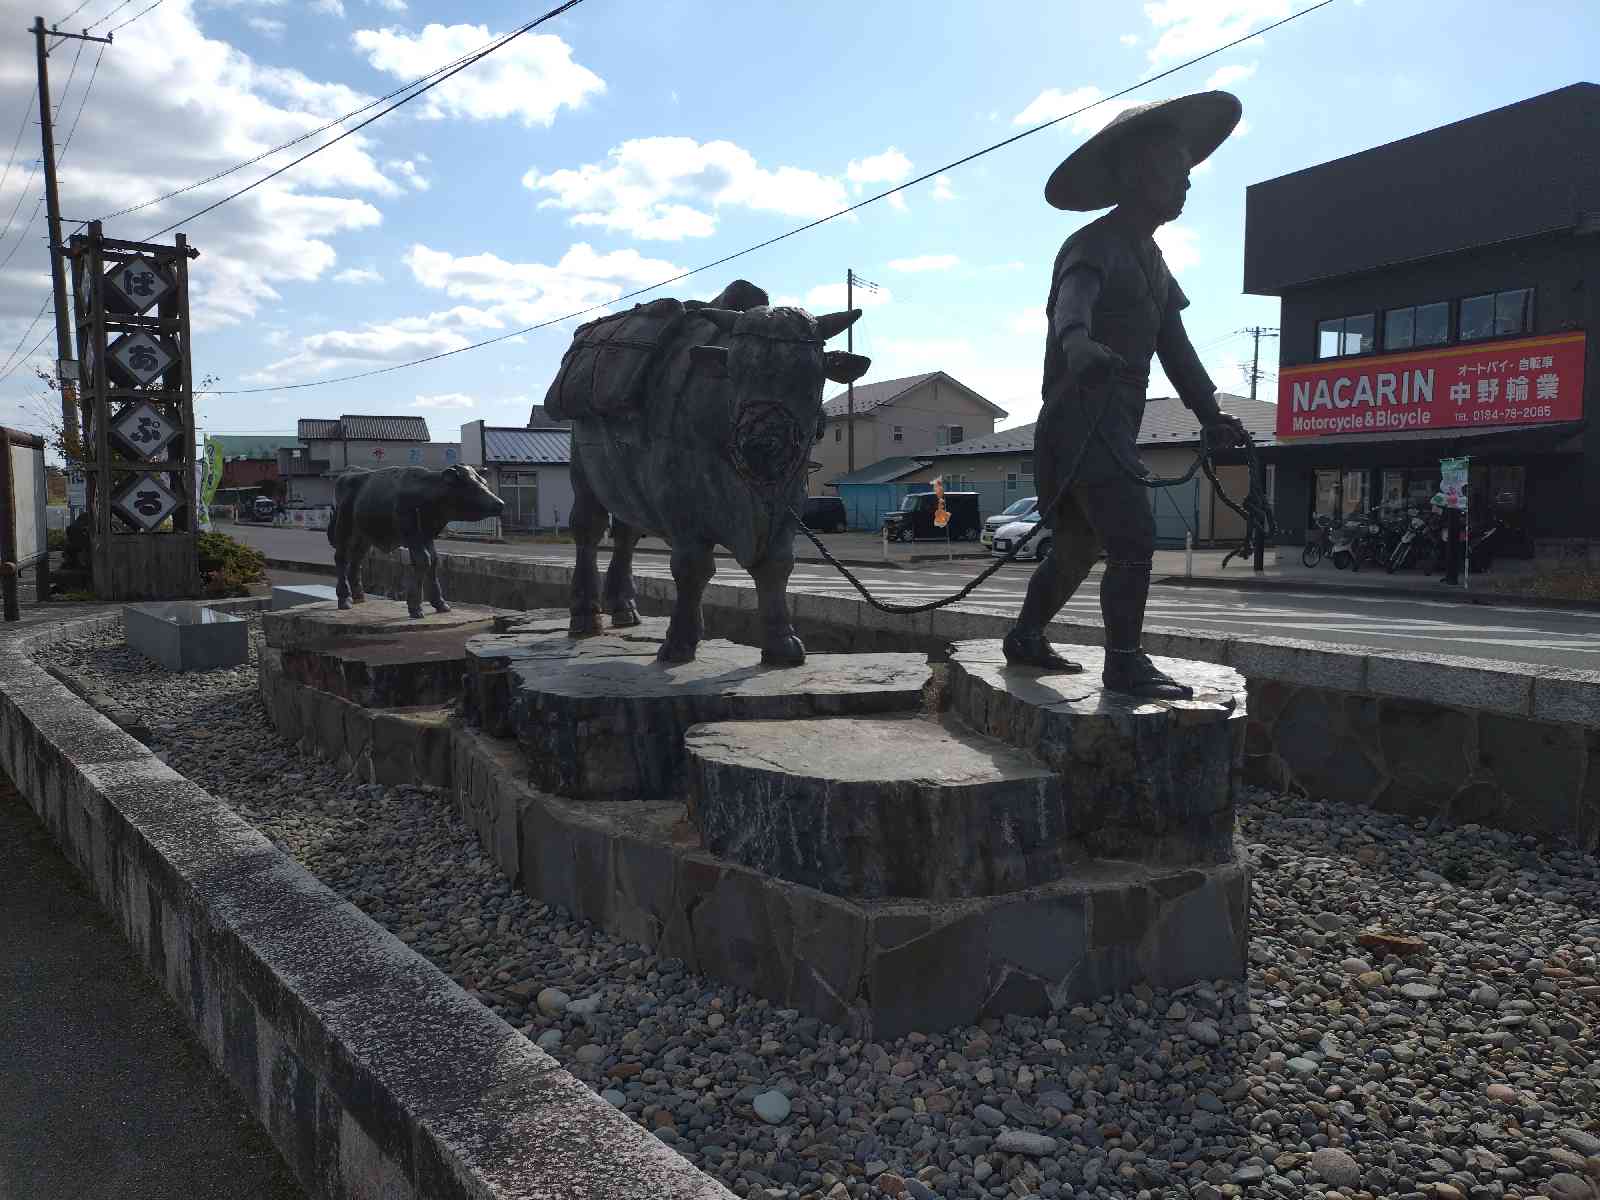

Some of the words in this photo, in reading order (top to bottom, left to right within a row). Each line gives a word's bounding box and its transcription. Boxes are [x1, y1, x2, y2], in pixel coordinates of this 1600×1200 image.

[1292, 368, 1436, 412] NACARIN
[1448, 374, 1560, 405] 中野輪業
